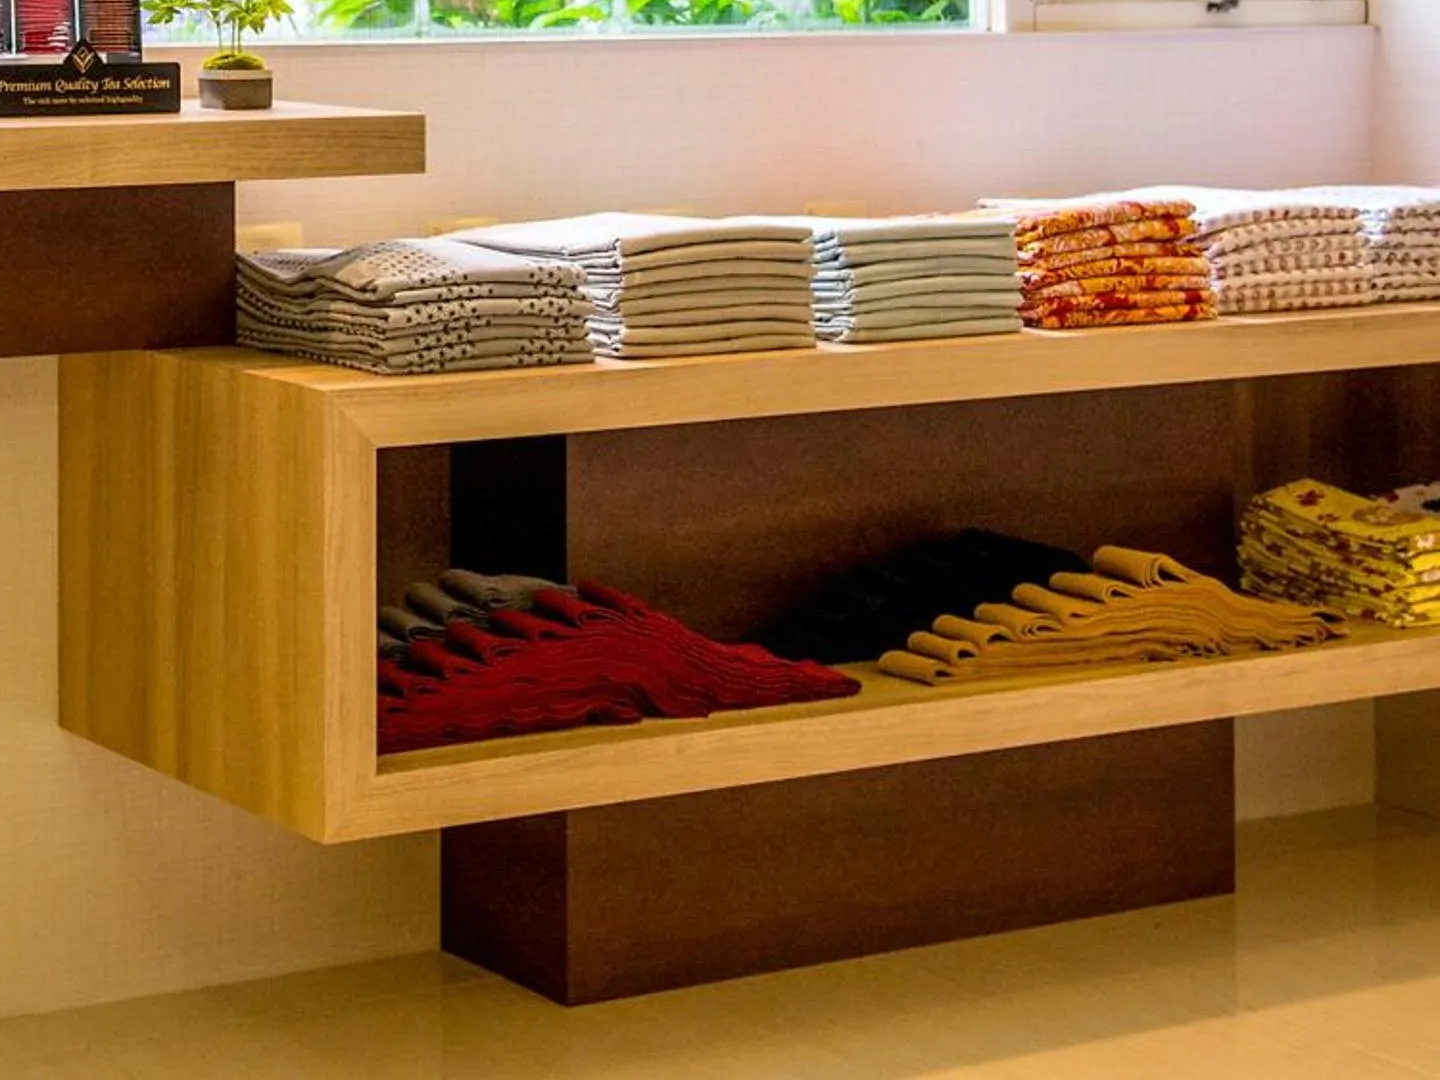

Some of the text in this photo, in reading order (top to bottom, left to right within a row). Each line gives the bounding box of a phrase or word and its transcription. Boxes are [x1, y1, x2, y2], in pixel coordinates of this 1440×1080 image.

[55, 76, 99, 94] Quality
[102, 77, 120, 91] Tea
[122, 76, 171, 90] Selection
